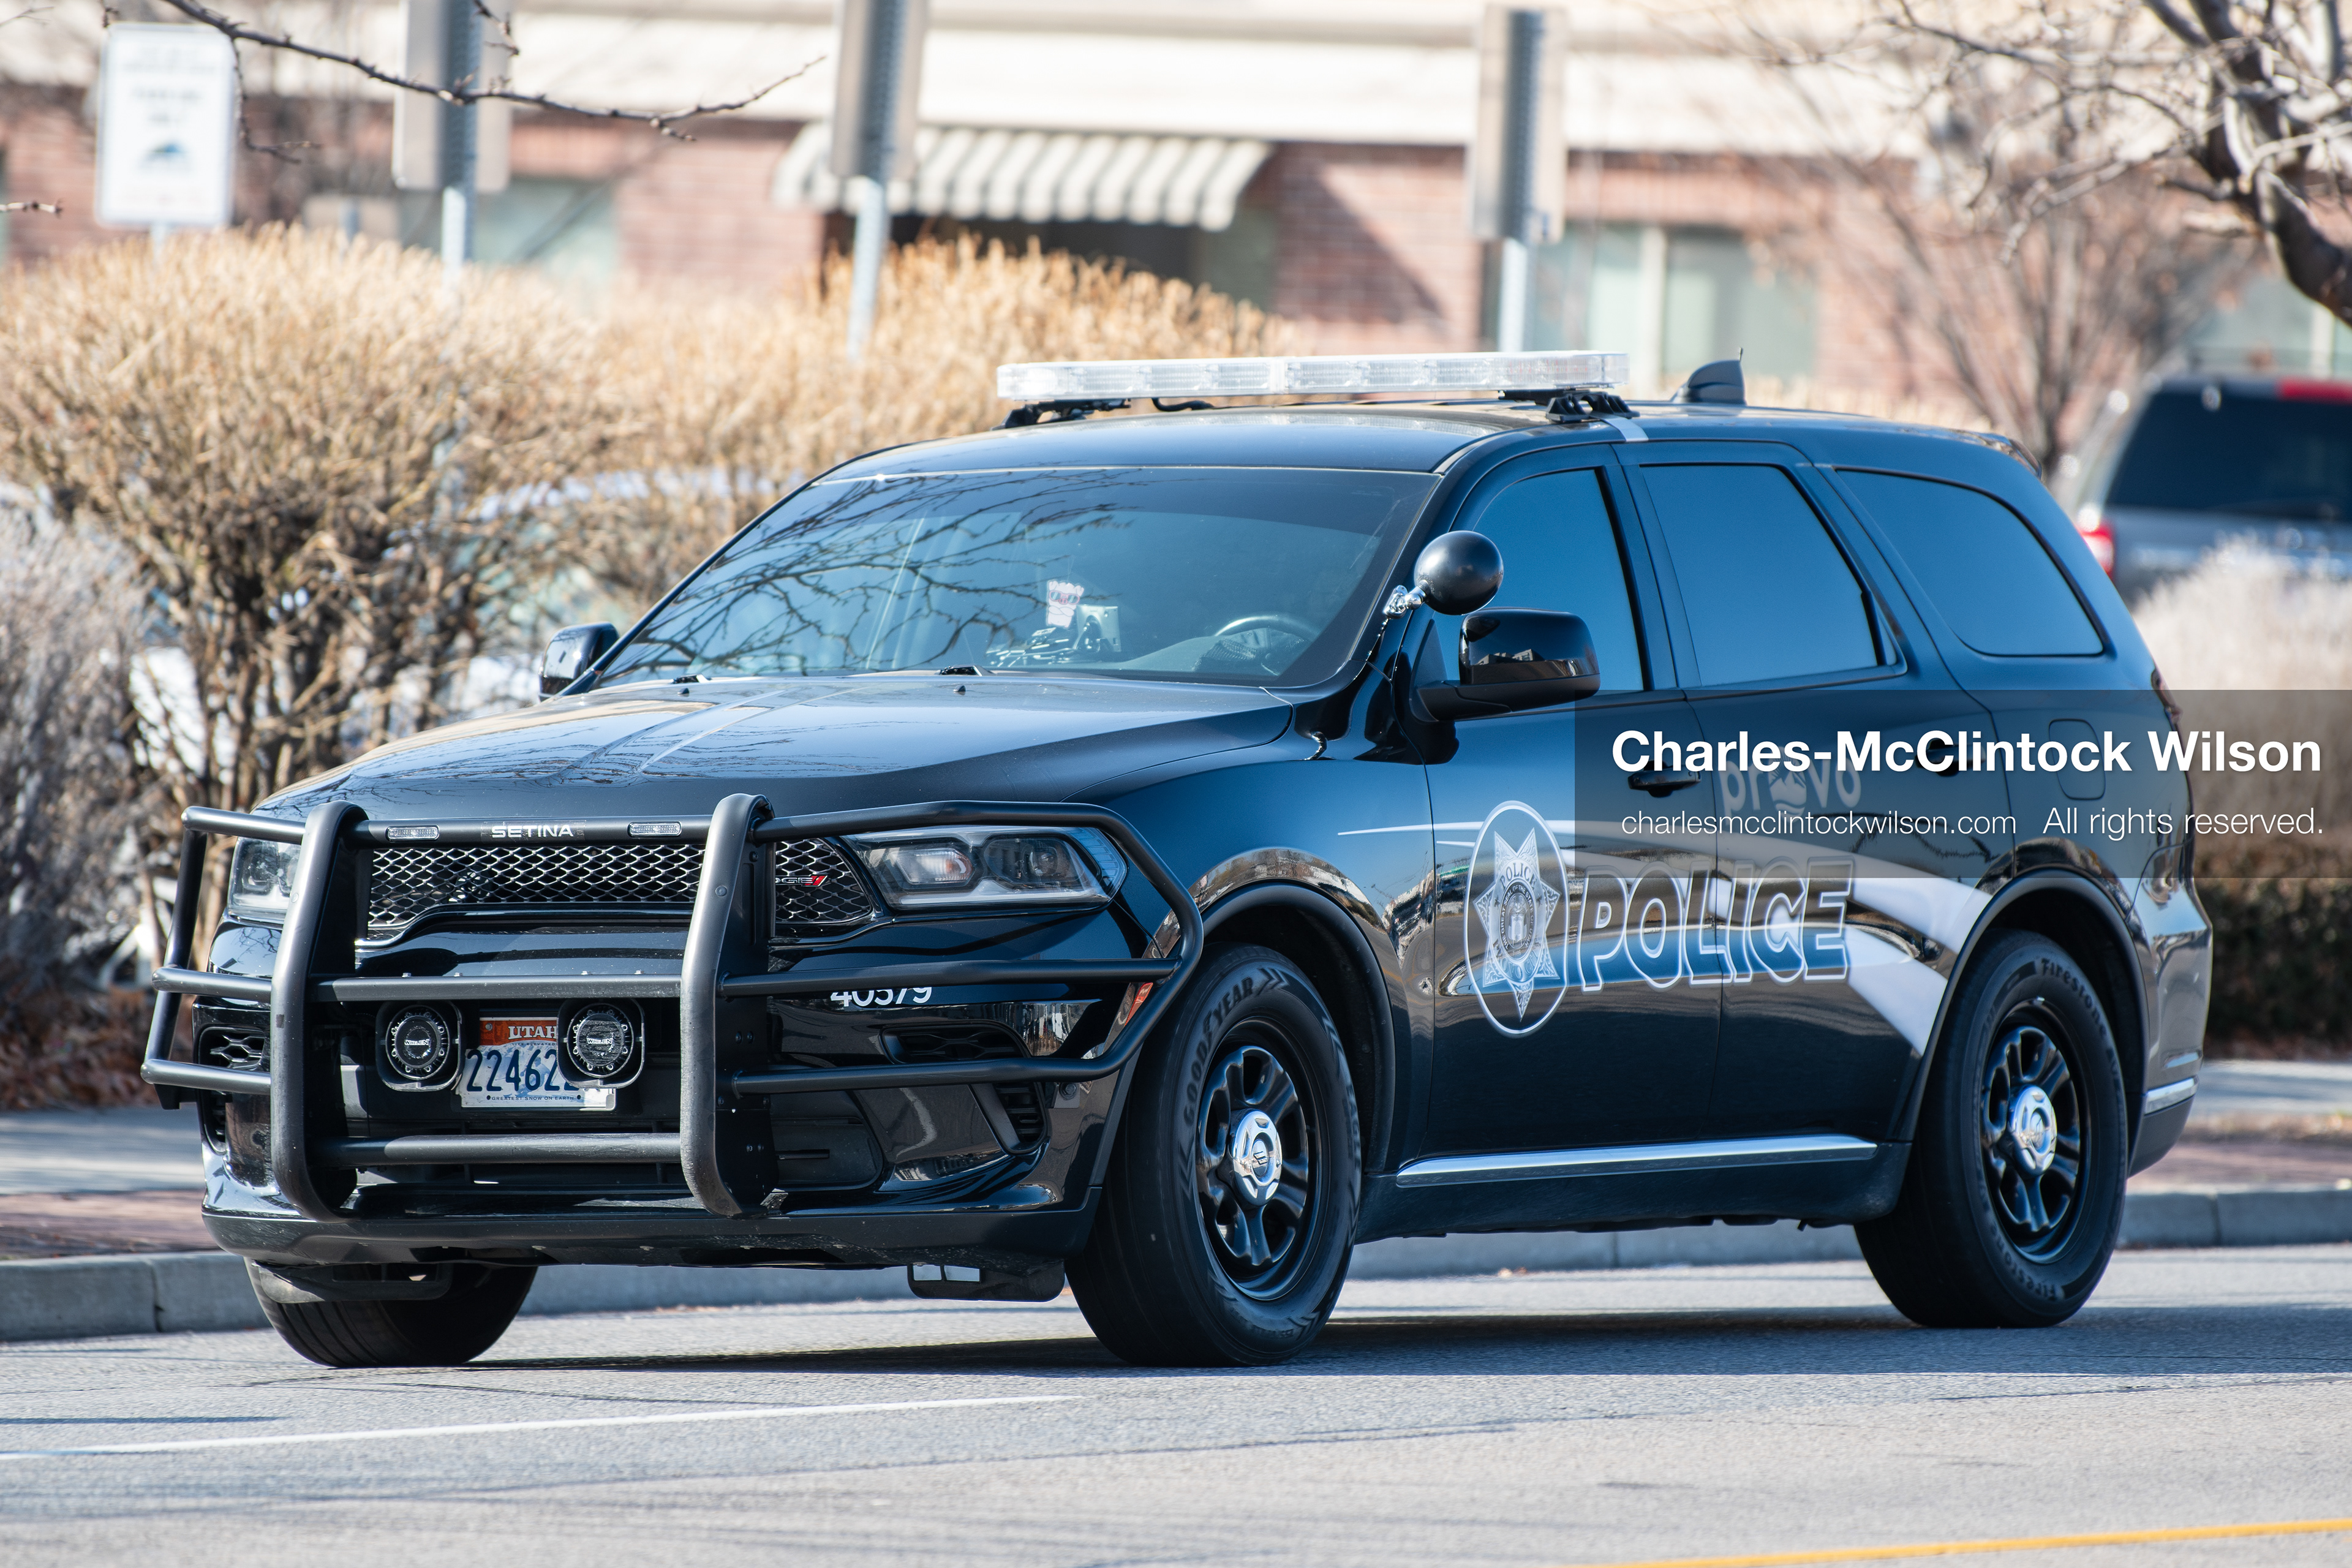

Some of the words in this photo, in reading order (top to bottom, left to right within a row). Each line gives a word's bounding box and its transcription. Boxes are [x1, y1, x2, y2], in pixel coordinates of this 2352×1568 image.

[491, 824, 574, 838] SETINA
[1499, 862, 1537, 891] POLICE
[1577, 859, 1854, 992] POLICE
[2041, 958, 2107, 1036] Firestone
[508, 1025, 557, 1040] UTAH
[1183, 977, 1253, 1126] GOODYEAR
[467, 1049, 580, 1091] 22462
